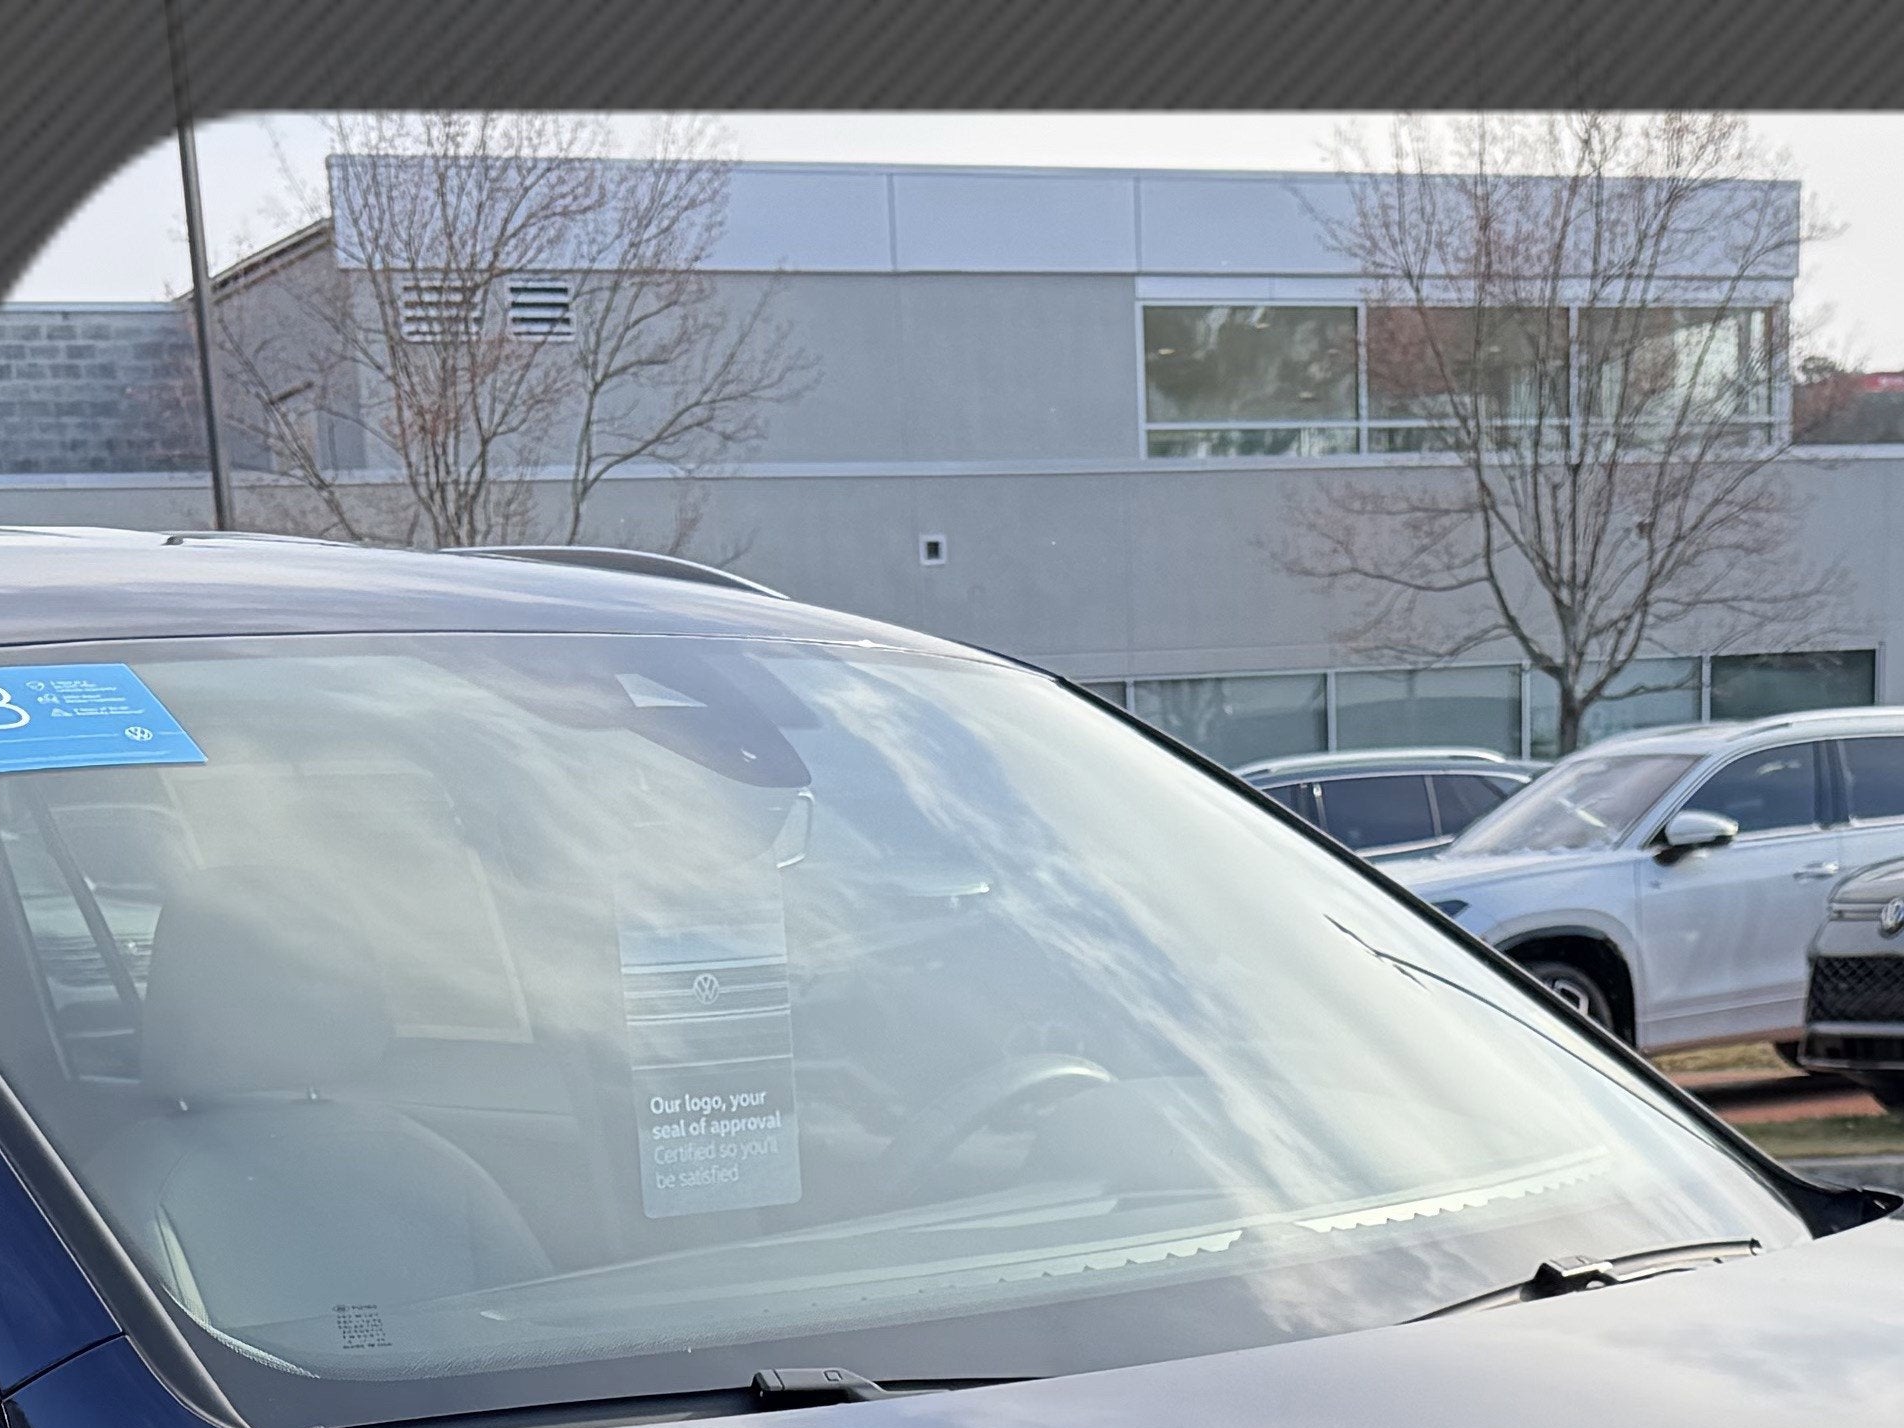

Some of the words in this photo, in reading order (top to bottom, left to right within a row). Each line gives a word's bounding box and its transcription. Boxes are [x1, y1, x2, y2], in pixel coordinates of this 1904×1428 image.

[650, 1096, 681, 1114] Our
[685, 1093, 726, 1114] logo,
[730, 1091, 767, 1112] your
[652, 1119, 686, 1139] seal
[689, 1116, 706, 1136] of
[710, 1110, 781, 1137] approval
[655, 1142, 716, 1164] Certified
[719, 1142, 737, 1158] so
[656, 1170, 676, 1188] be
[679, 1162, 738, 1187] satisfied
